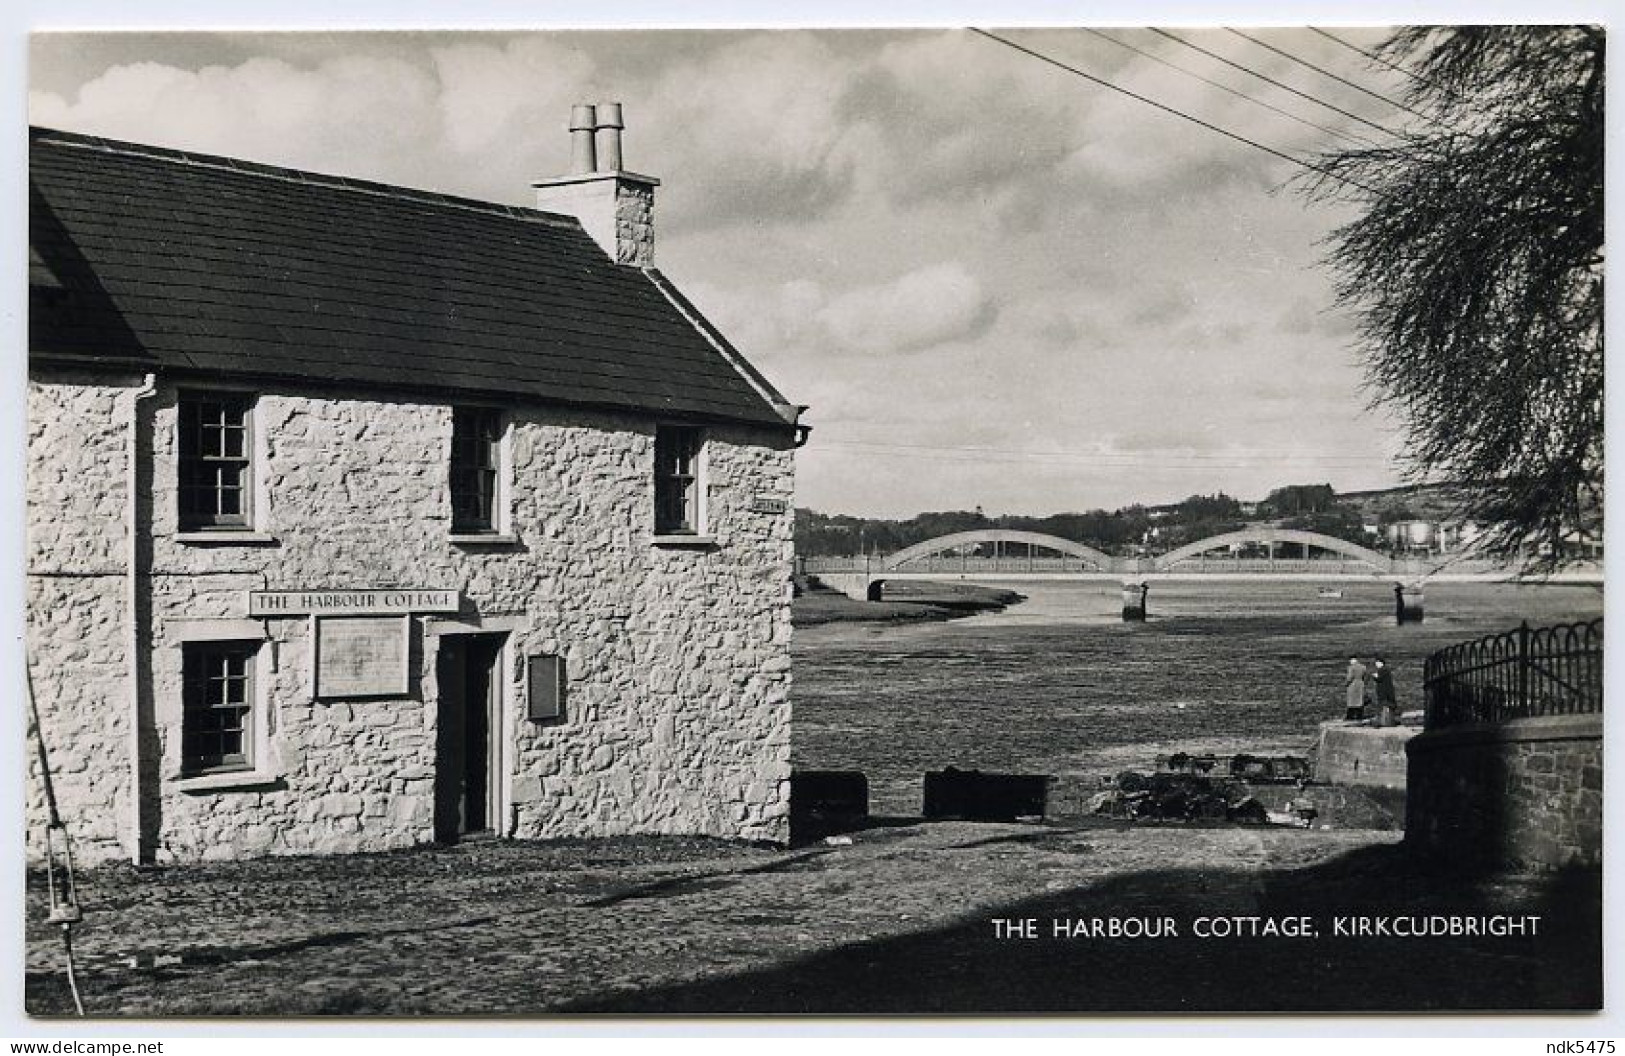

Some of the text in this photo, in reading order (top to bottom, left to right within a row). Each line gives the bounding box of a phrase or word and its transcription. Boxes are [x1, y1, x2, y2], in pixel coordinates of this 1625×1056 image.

[259, 593, 451, 609] THE HARBOUR COTTAGE
